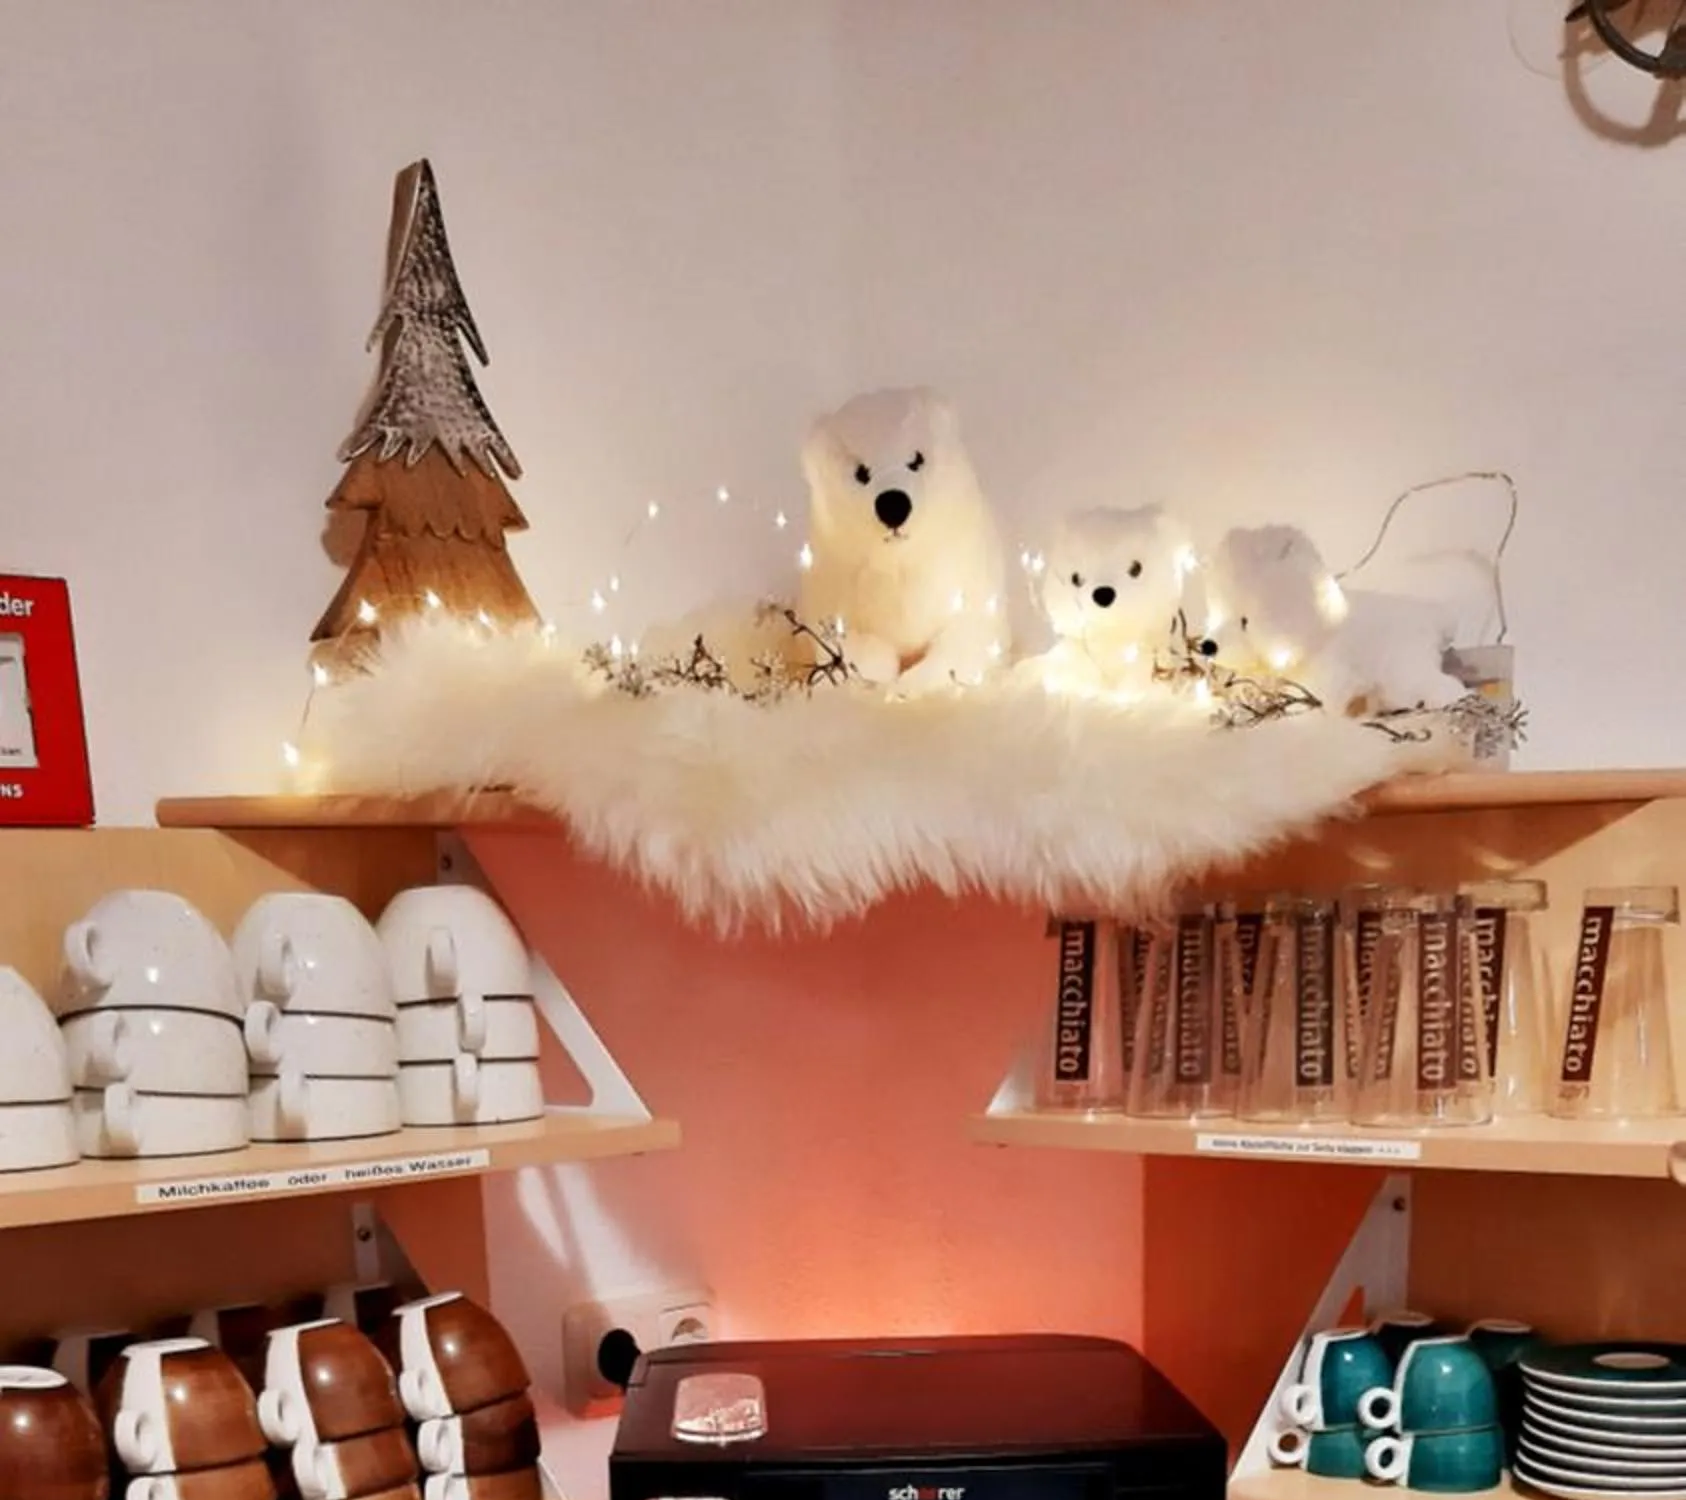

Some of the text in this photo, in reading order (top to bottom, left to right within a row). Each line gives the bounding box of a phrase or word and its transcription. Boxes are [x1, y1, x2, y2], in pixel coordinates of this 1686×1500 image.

[1059, 929, 1087, 1073] macchiato
[1300, 924, 1329, 1078] macchiato
[1420, 921, 1452, 1081] macchiato
[1565, 915, 1602, 1072] macchiato
[158, 1156, 472, 1198] Milchkaffee oder heißes Wasser
